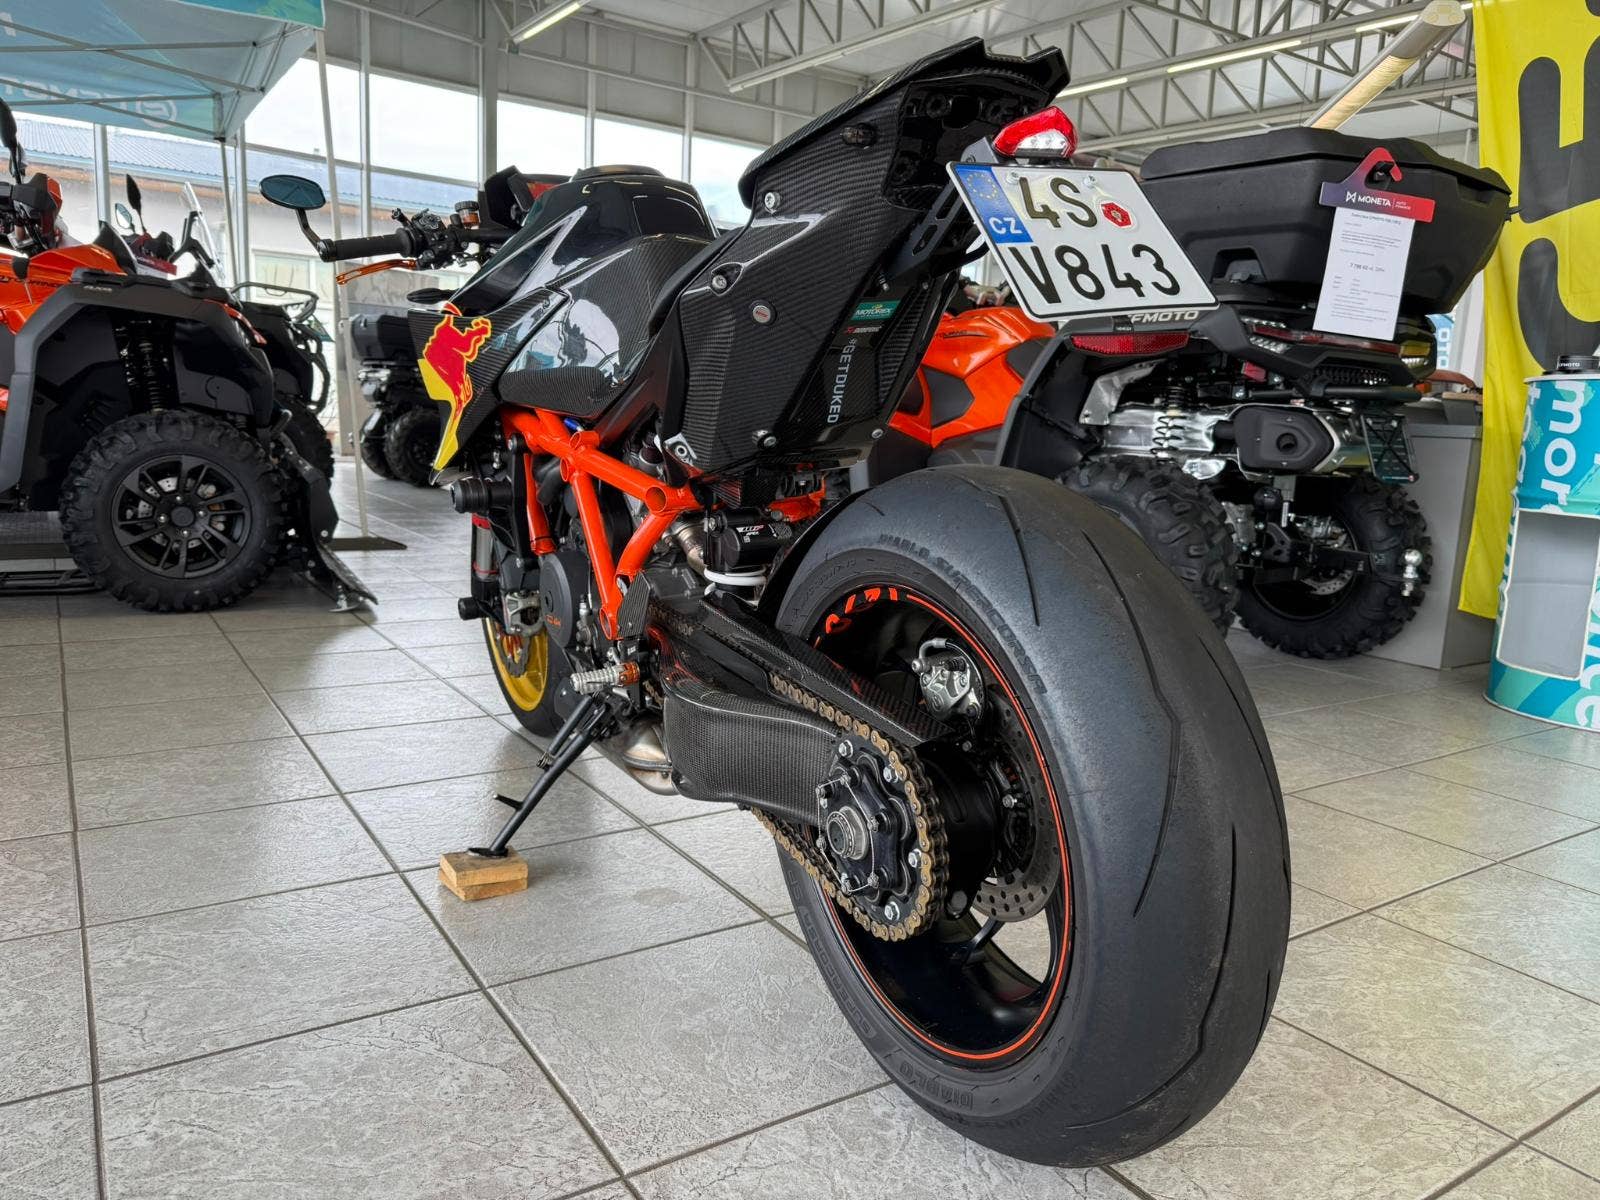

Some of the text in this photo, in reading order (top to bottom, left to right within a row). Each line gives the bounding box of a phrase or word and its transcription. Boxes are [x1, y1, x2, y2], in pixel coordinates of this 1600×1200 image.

[988, 217, 1023, 235] CZ
[1019, 177, 1098, 229] 4S
[1358, 195, 1392, 207] MONETA
[1008, 243, 1181, 304] V843
[1127, 310, 1200, 325] FMOTO
[1541, 380, 1587, 514] mor
[898, 1060, 974, 1112] DIABLO
